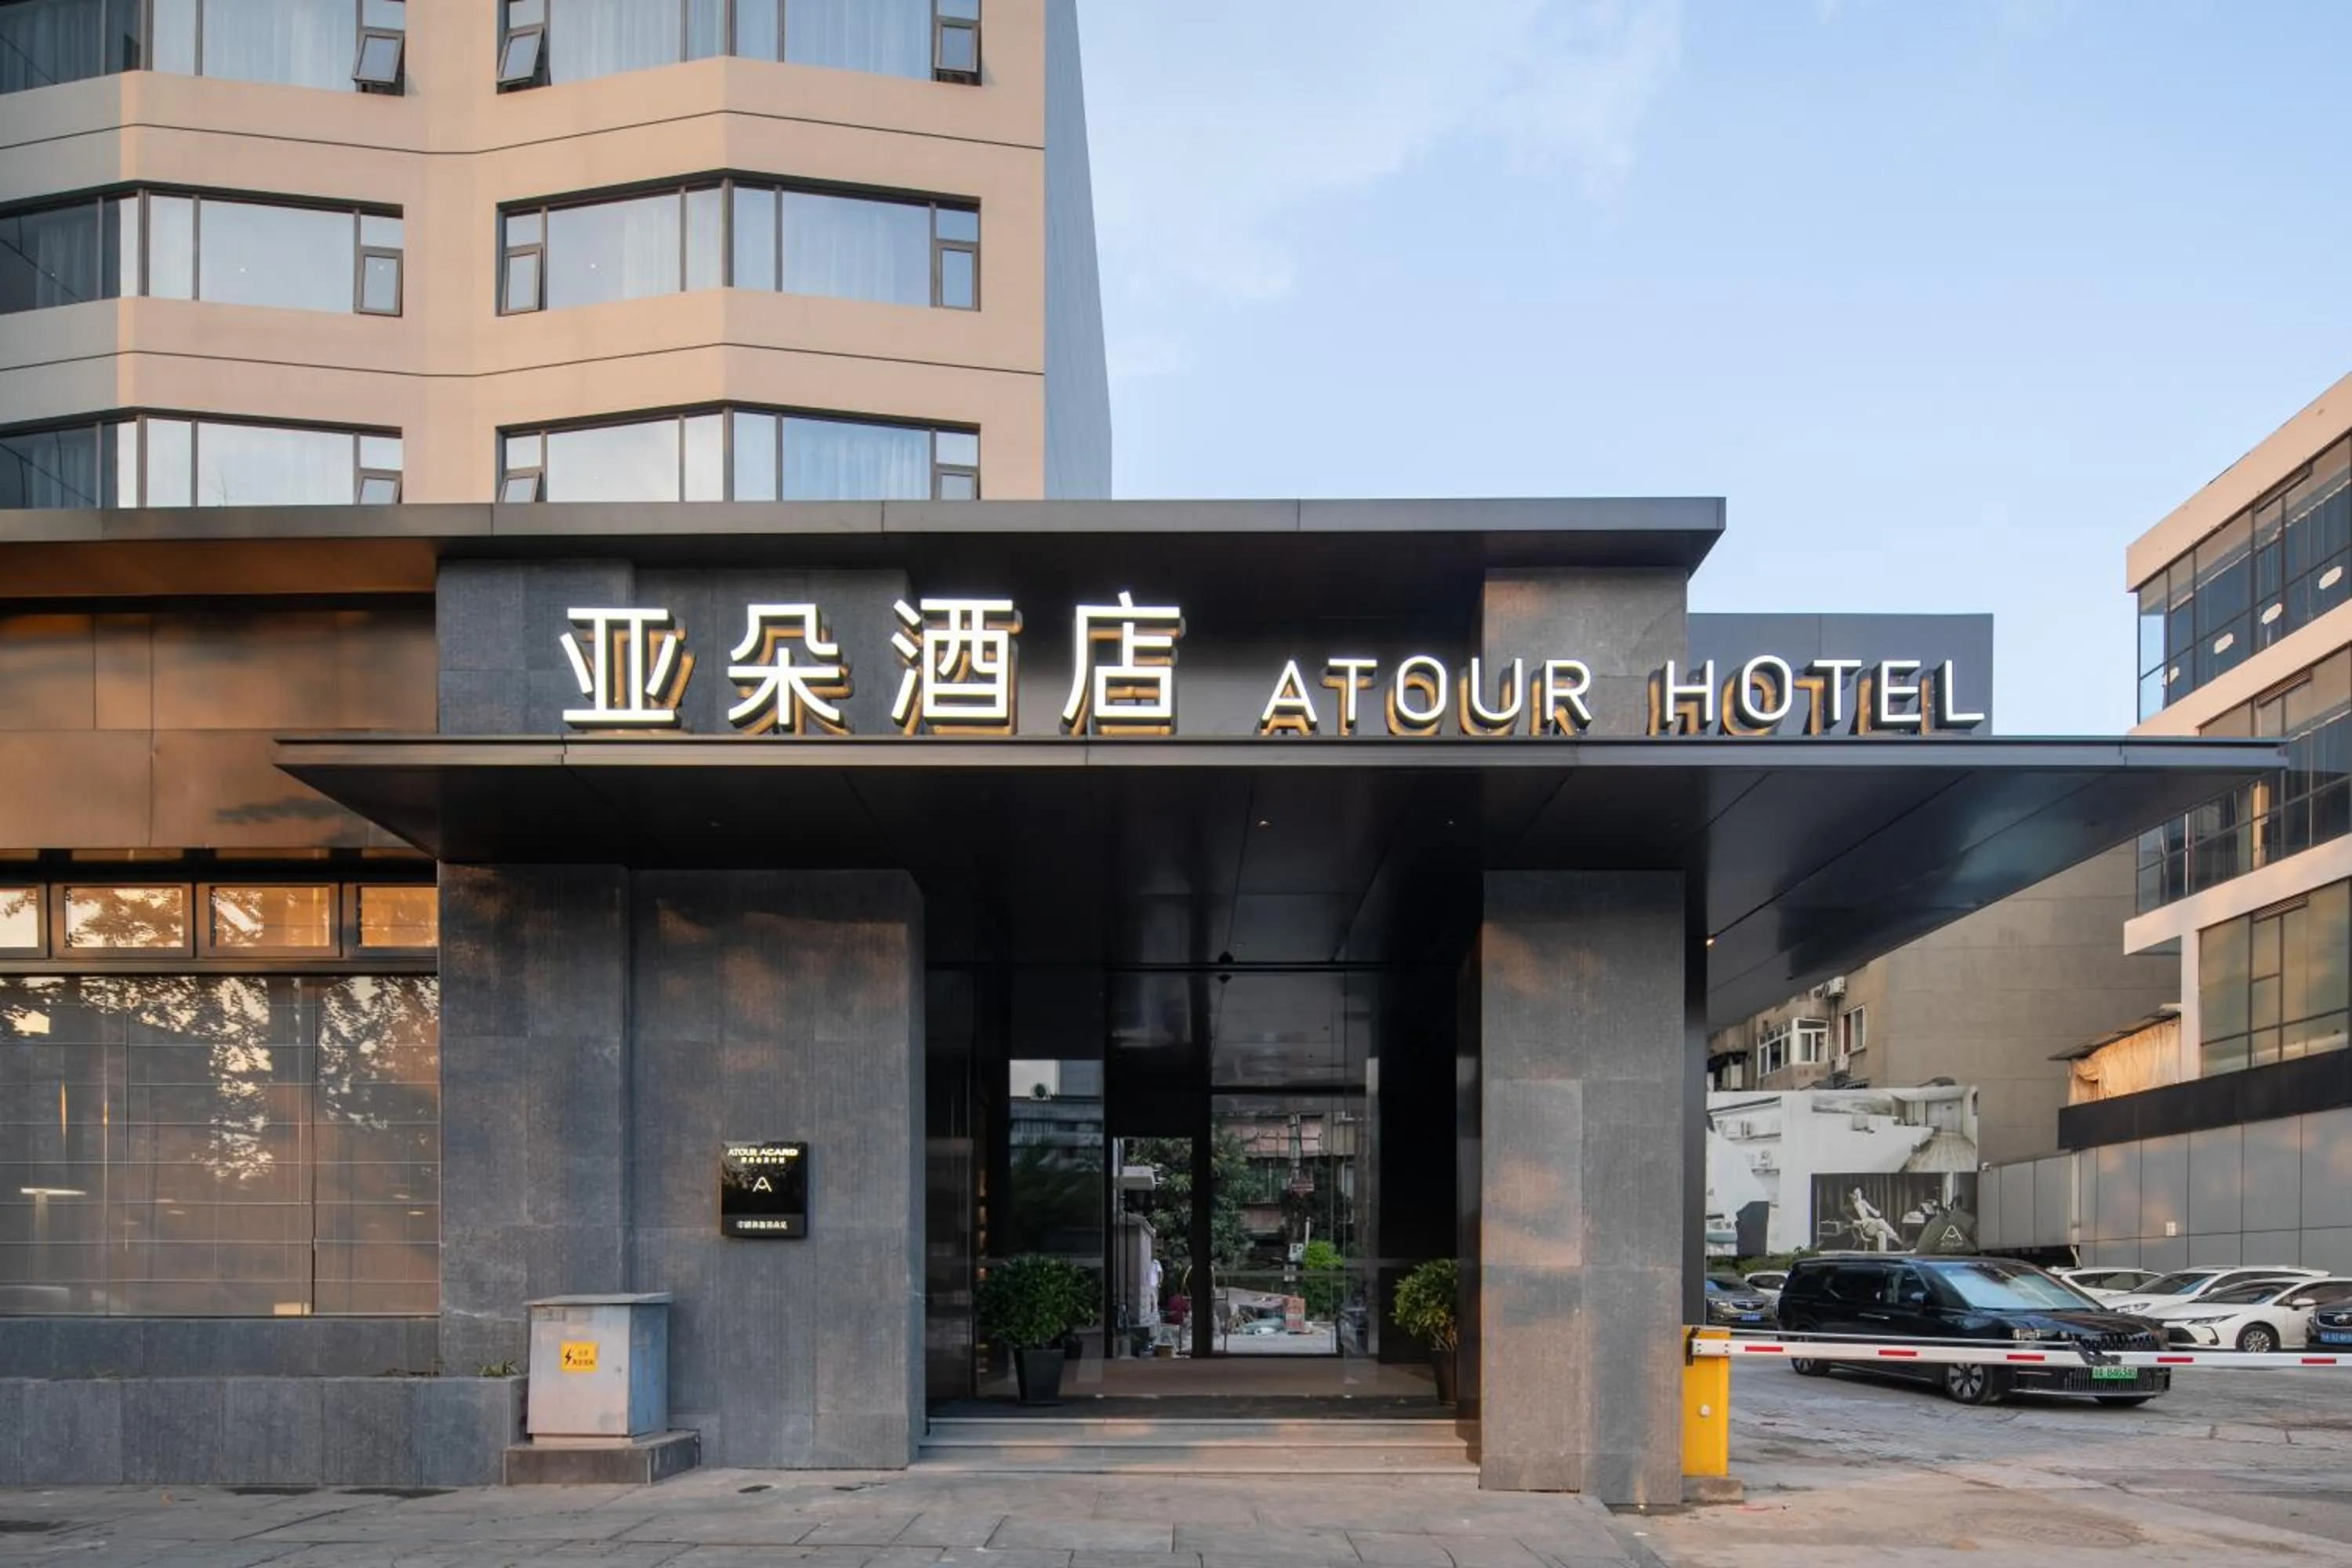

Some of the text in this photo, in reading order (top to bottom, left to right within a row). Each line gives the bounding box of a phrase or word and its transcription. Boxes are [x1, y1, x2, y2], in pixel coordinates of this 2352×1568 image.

[560, 591, 1180, 724] 亚朵酒店
[1261, 655, 1985, 722] ATOUR HOTEL
